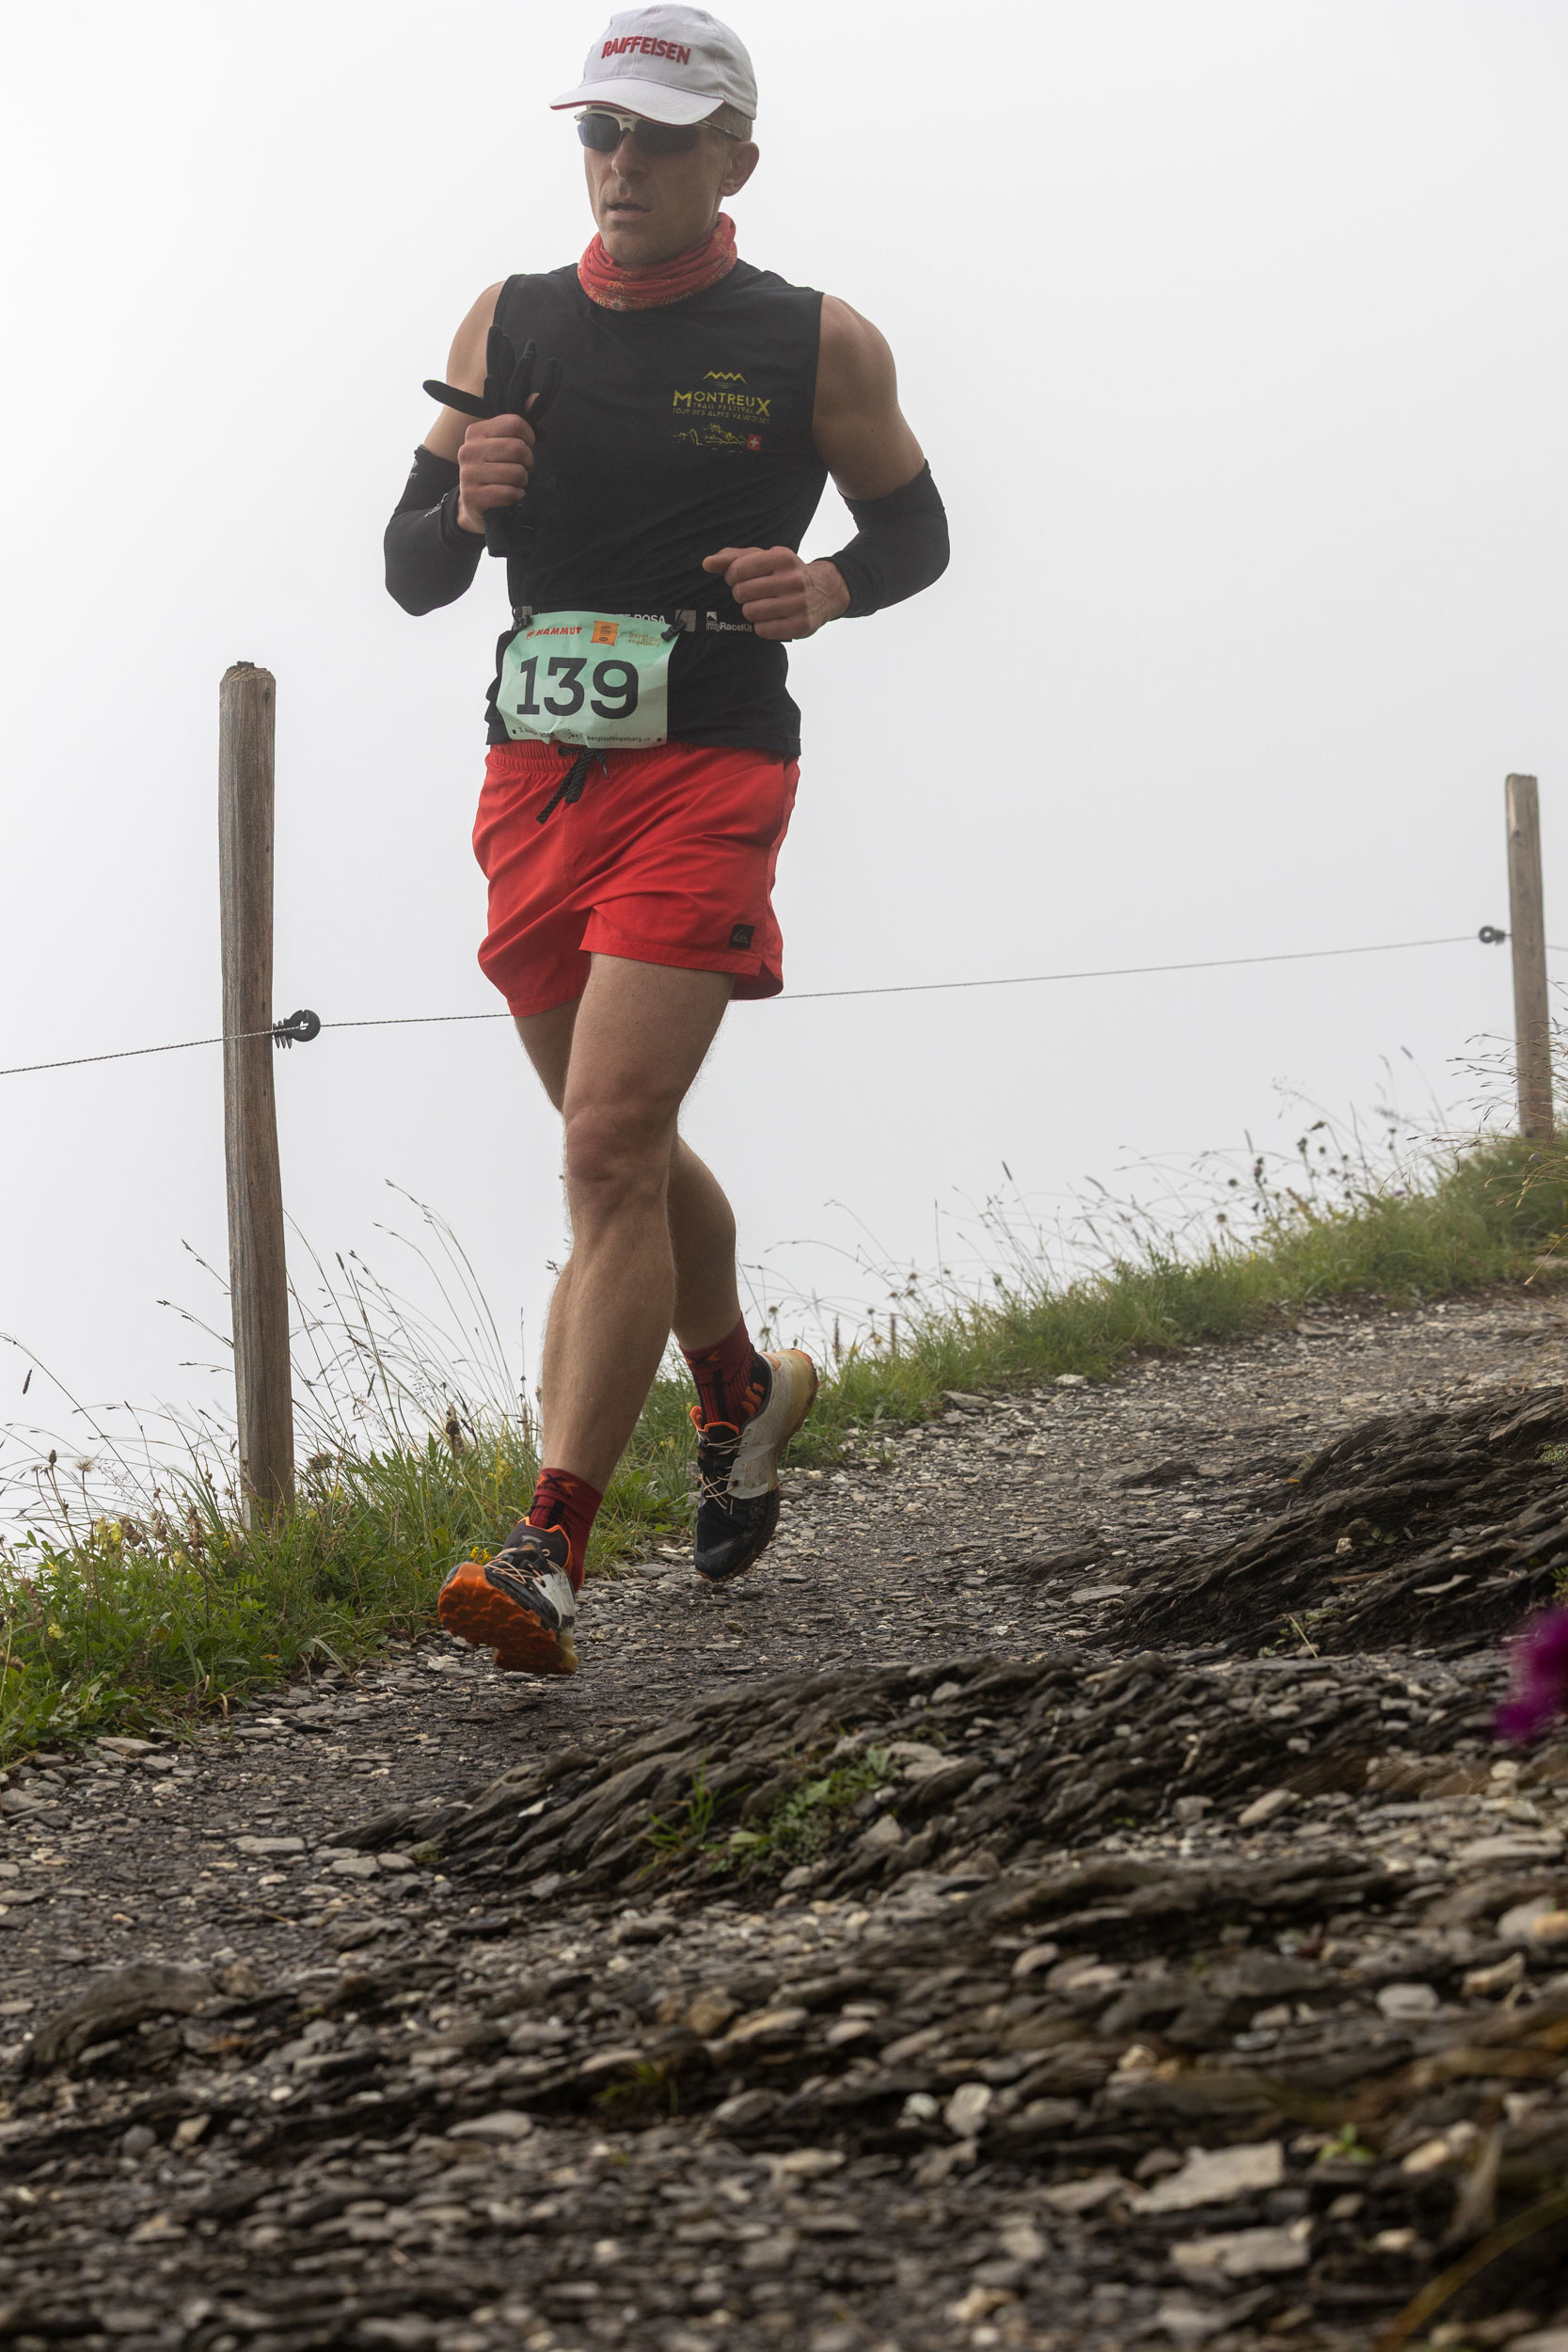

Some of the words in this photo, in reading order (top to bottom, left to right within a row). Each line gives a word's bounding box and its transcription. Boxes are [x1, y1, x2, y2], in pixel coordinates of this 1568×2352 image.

[601, 36, 691, 65] RAIFFEISEN
[673, 389, 771, 417] MONTREUX
[719, 405, 753, 414] FESTIVAL
[535, 627, 582, 636] MAMMUT
[706, 622, 753, 631] myRaceKit
[516, 656, 640, 720] 139
